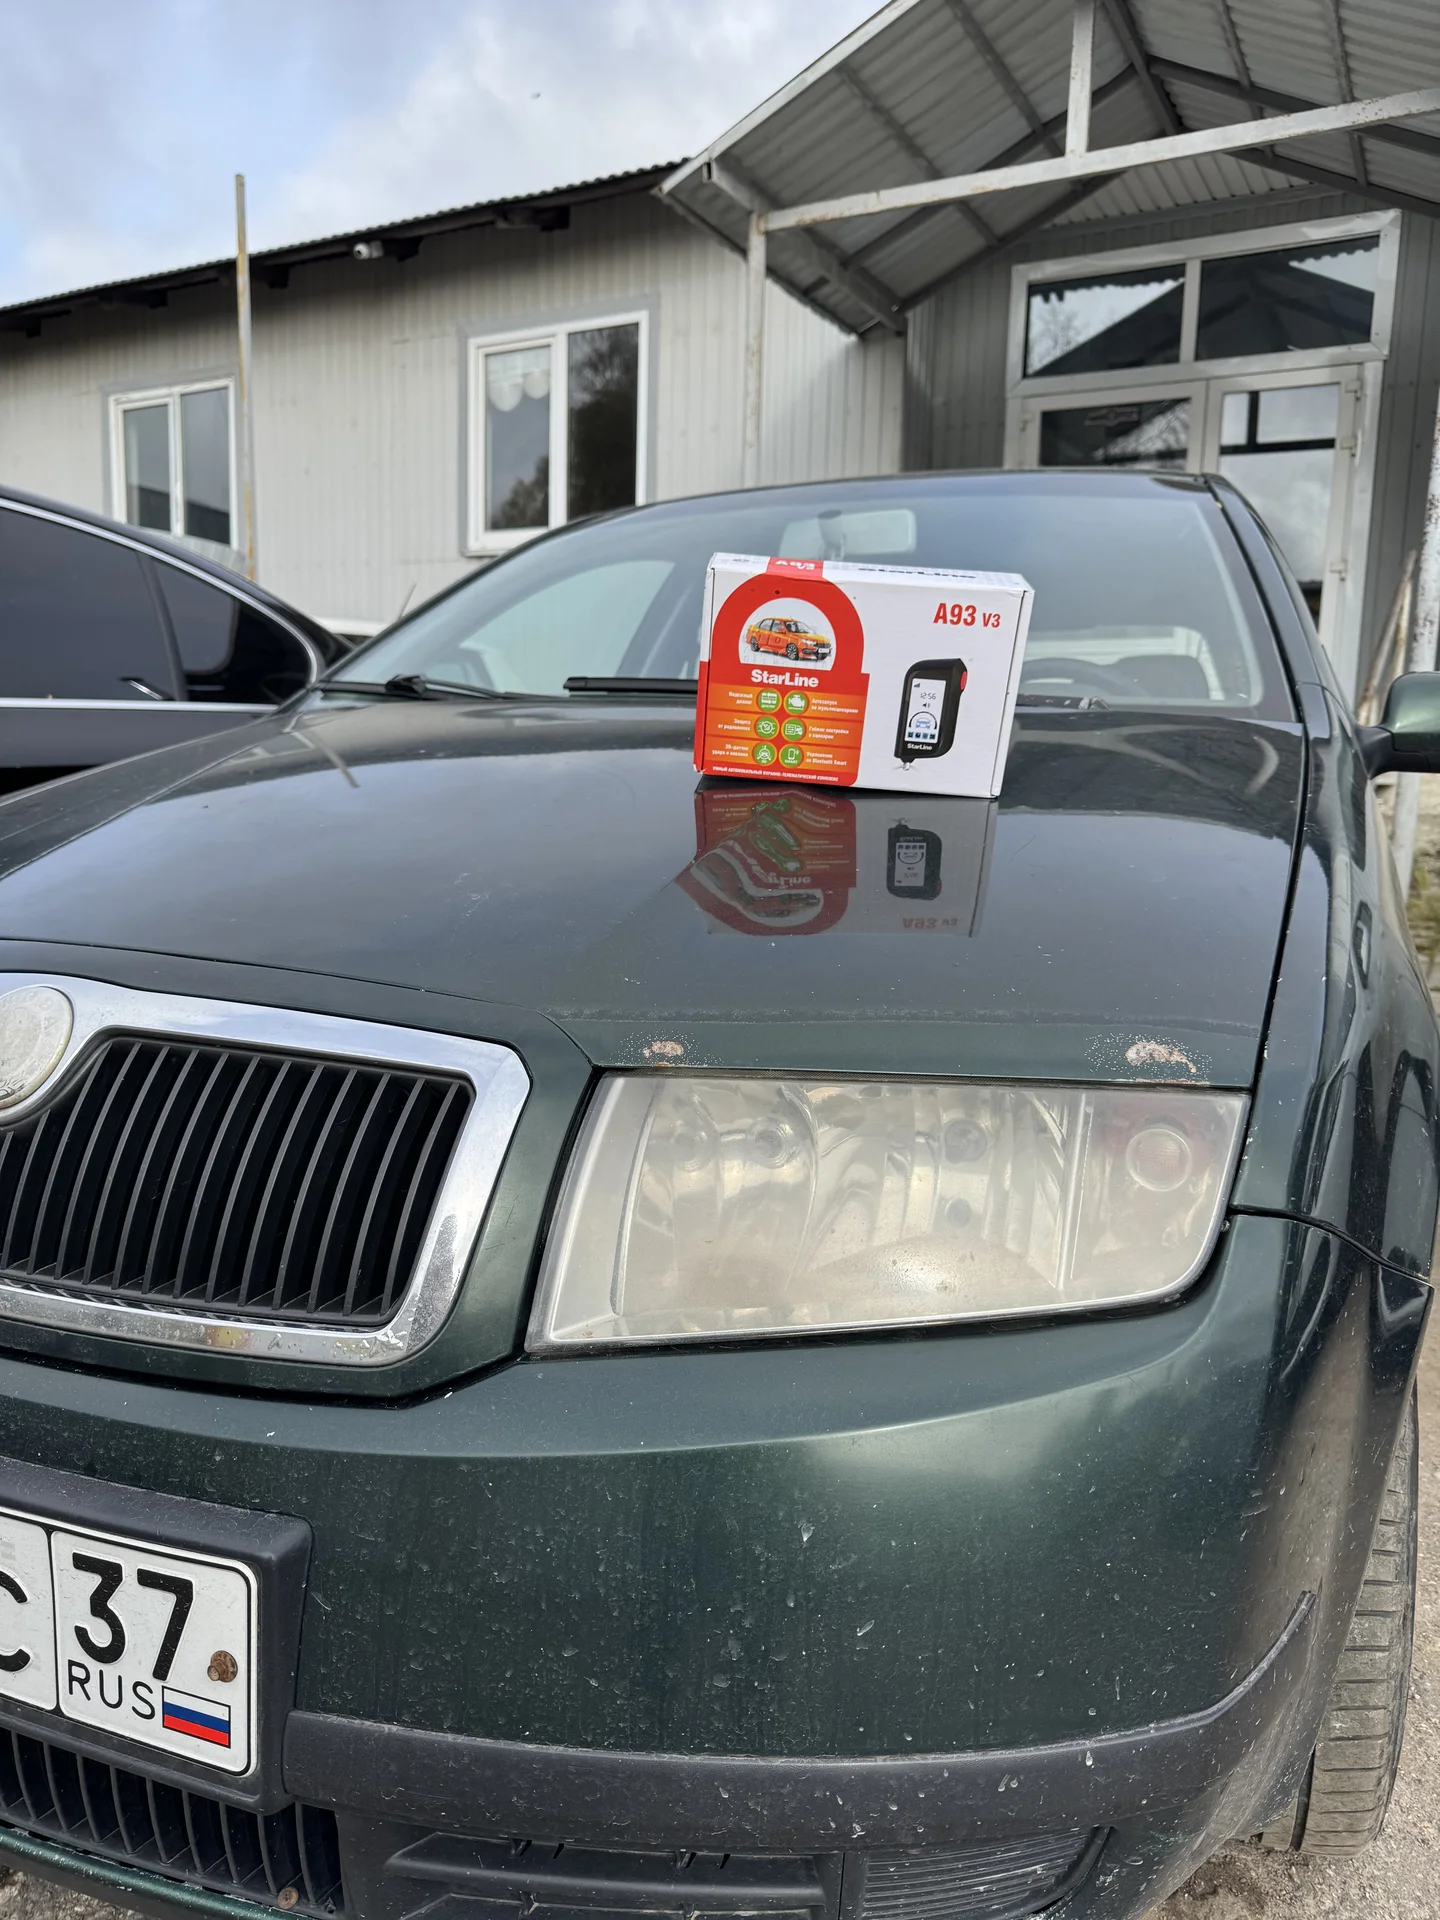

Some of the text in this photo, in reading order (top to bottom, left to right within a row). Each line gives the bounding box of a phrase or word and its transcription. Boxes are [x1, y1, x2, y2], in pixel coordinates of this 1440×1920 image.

[933, 602, 1001, 629] A93 V3
[751, 669, 819, 687] StarLine
[907, 743, 933, 751] StarLine
[72, 1551, 194, 1681] 37
[67, 1659, 156, 1720] RUS
